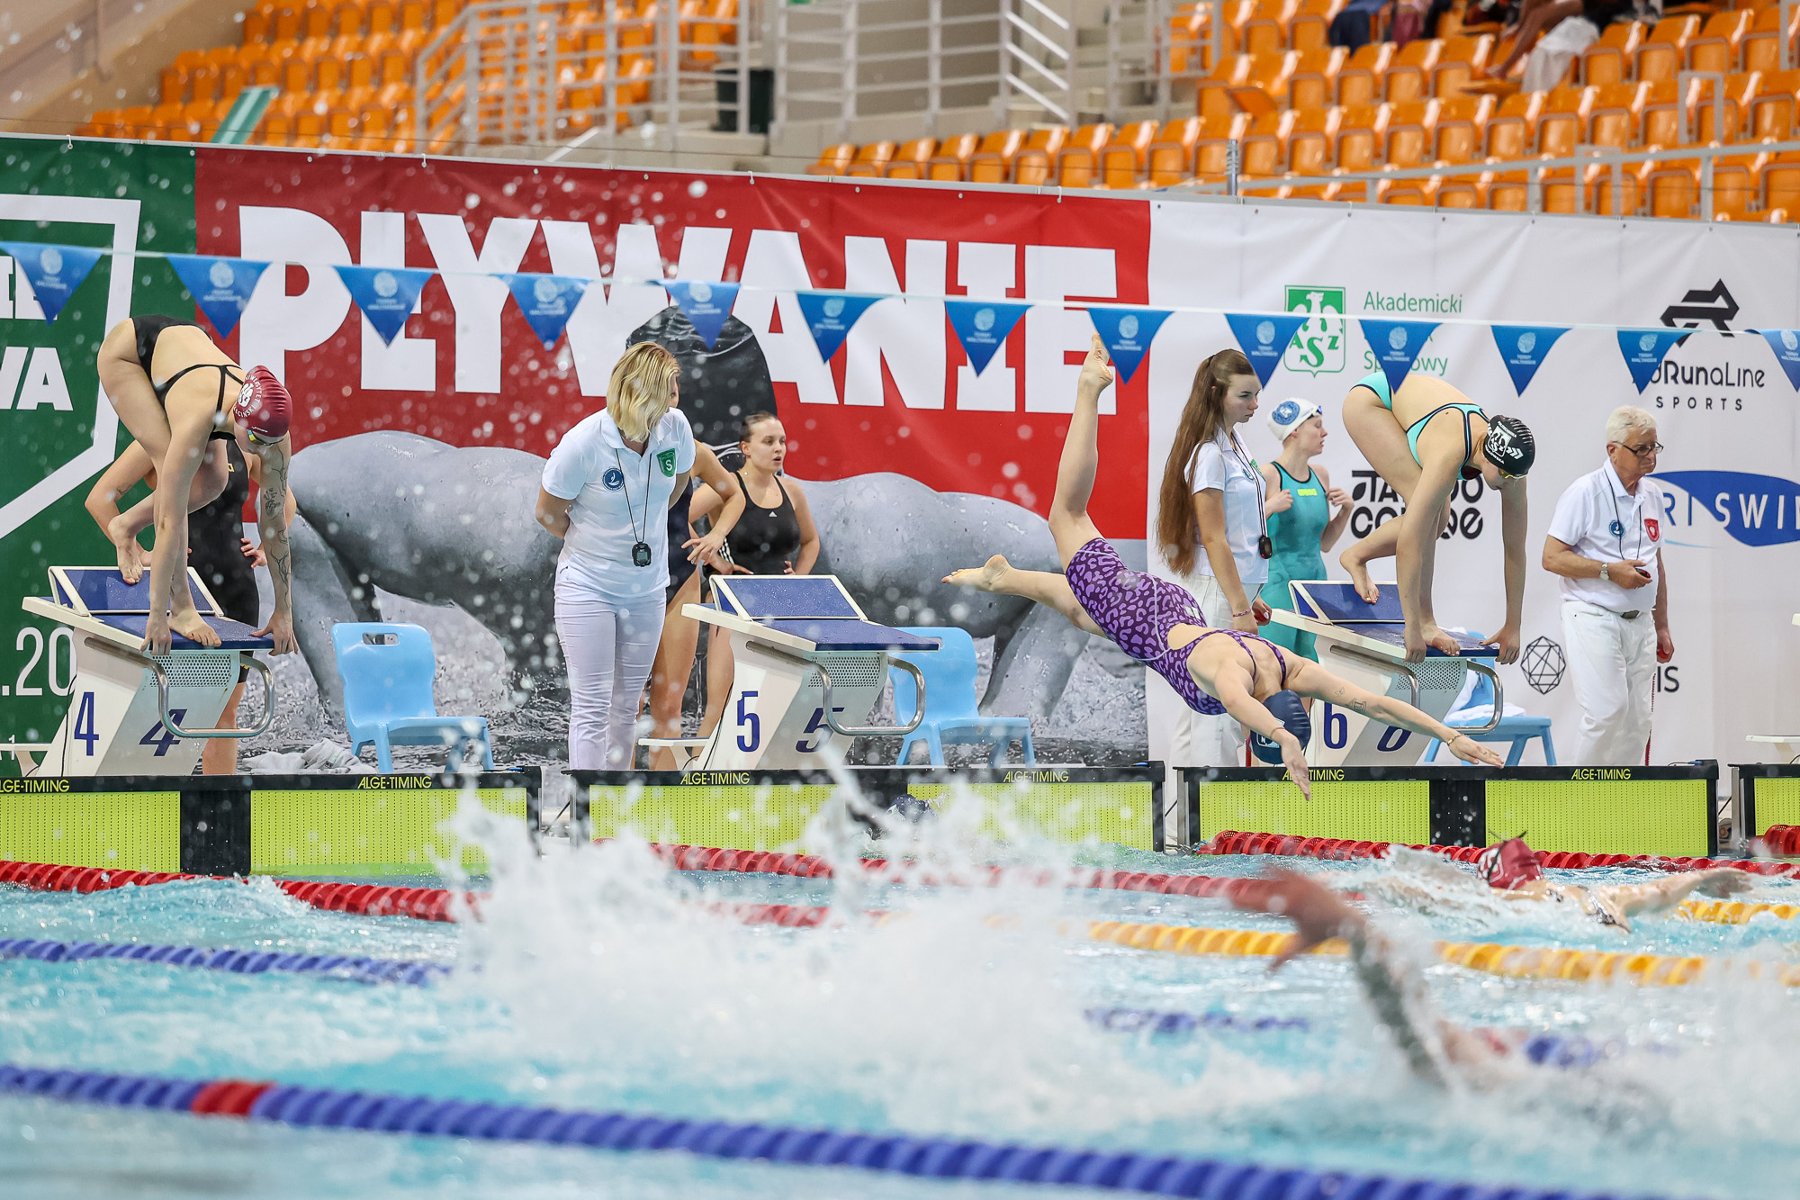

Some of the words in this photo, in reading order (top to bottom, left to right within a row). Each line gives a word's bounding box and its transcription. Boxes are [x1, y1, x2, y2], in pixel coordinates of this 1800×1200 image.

[239, 205, 1118, 415] PŁYWANIE
[1363, 291, 1463, 313] Akademicki
[1363, 350, 1448, 376] Spowy
[1656, 396, 1743, 411] SPORTS
[1714, 492, 1800, 530] SWI
[74, 691, 100, 757] 4
[139, 708, 188, 757] 4
[736, 690, 760, 753] 5
[795, 707, 845, 753] 5
[1323, 701, 1348, 750] 6
[357, 776, 432, 789] ALGE-TIMING
[680, 772, 750, 785] ALGE-TIMING
[1003, 770, 1069, 783] ALGE-TIMING
[1282, 769, 1345, 781] ATIMING
[1571, 768, 1632, 780] ALGE-TIMING
